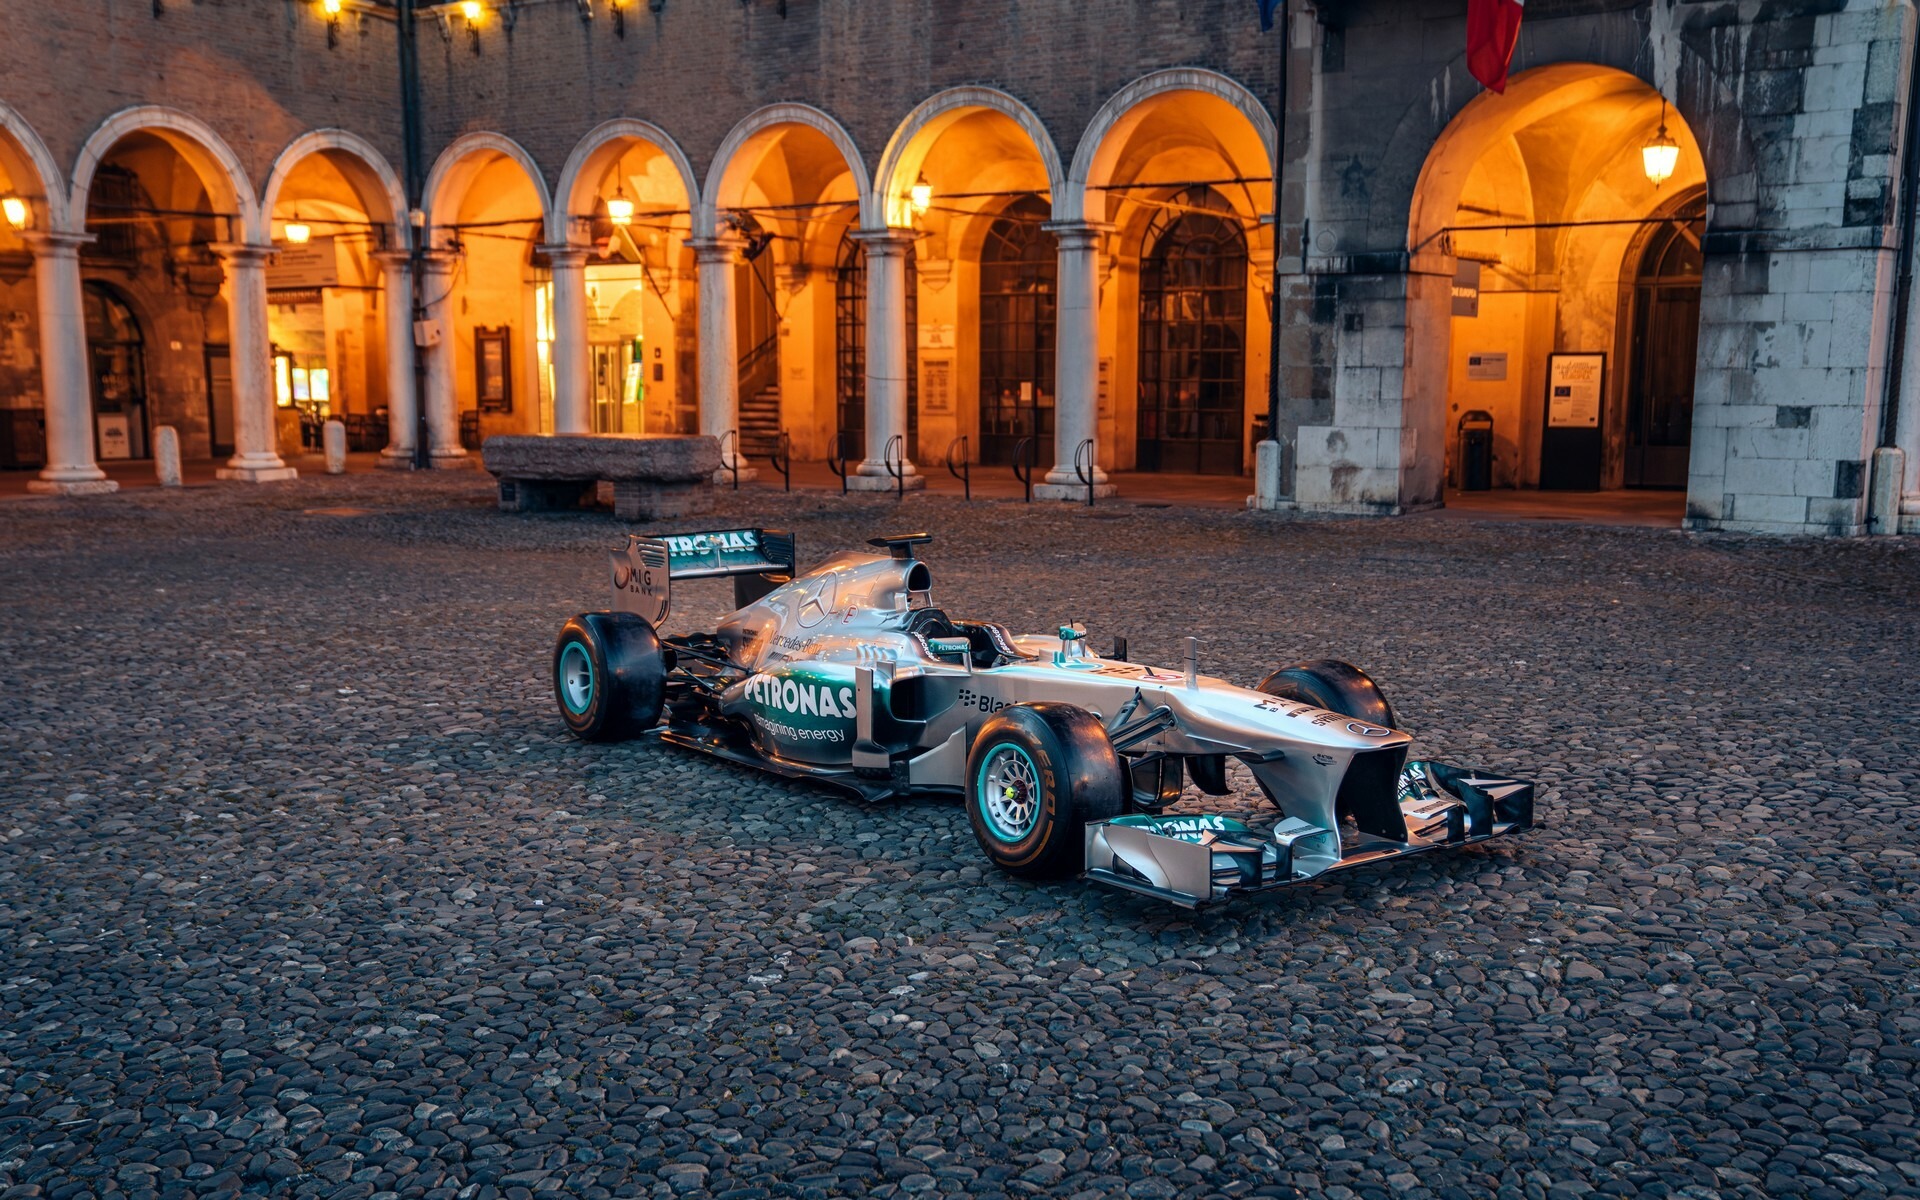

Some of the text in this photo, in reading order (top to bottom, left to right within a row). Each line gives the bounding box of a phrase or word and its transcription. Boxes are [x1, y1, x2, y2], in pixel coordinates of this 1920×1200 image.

[630, 568, 651, 585] MIG
[630, 584, 652, 597] BANK
[744, 673, 857, 719] PETRONAS
[979, 695, 1018, 714] Bla
[798, 728, 845, 742] energy
